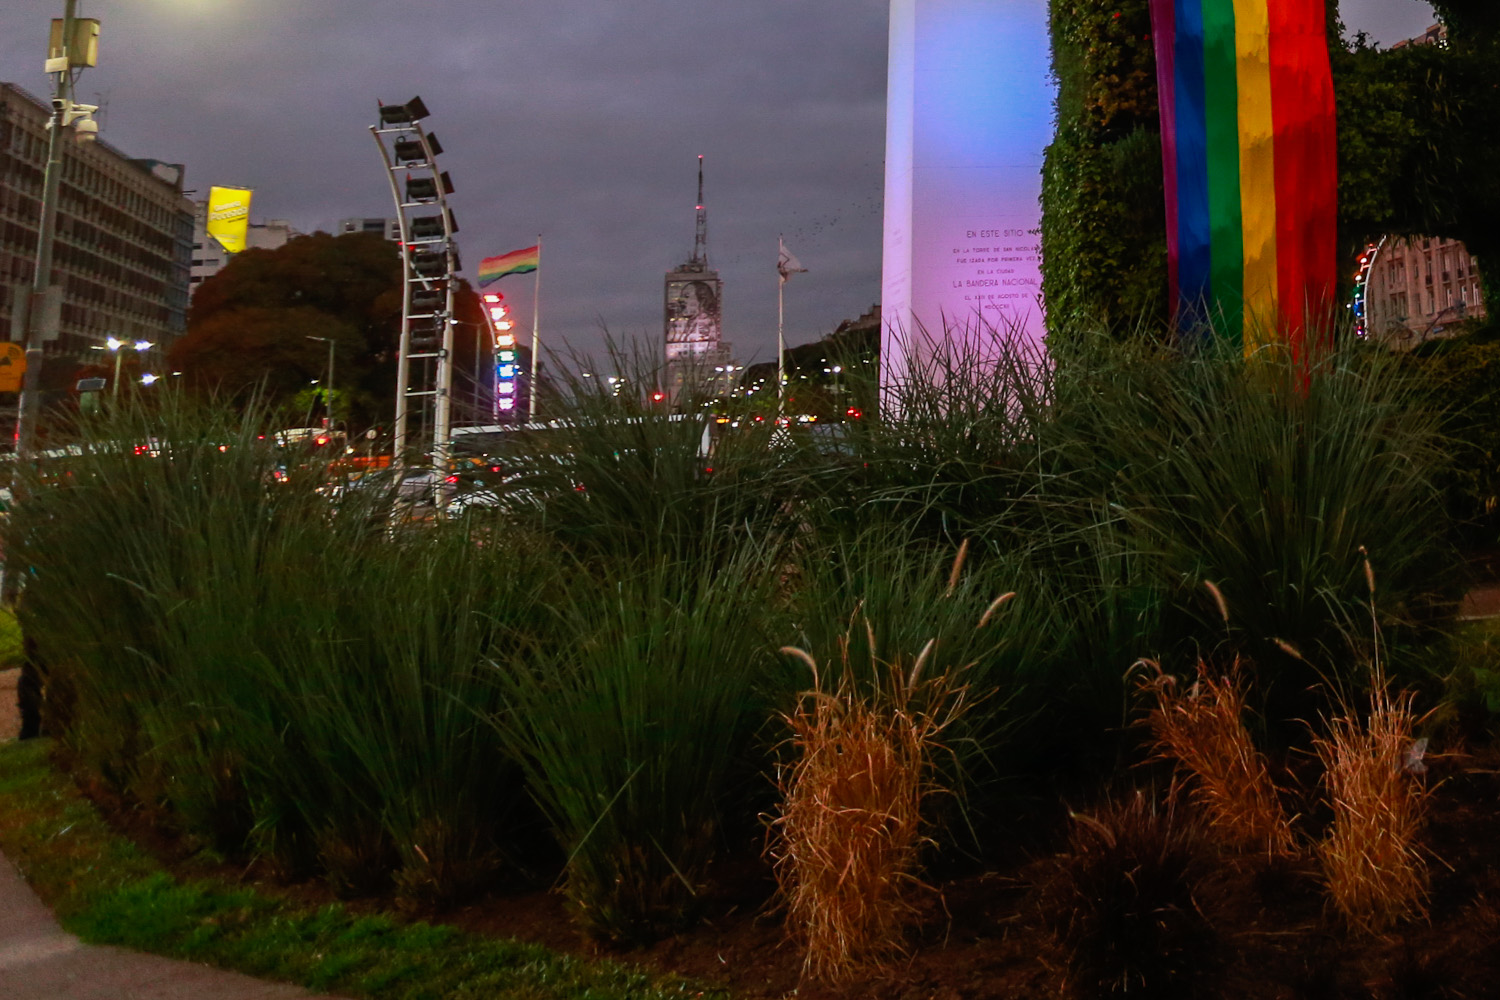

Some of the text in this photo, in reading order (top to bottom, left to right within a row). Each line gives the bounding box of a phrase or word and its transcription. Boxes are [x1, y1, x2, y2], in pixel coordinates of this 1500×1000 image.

[966, 229, 1024, 238] EN ESTE SITIO
[952, 278, 1038, 289] LA BANDERA NACIONAL
